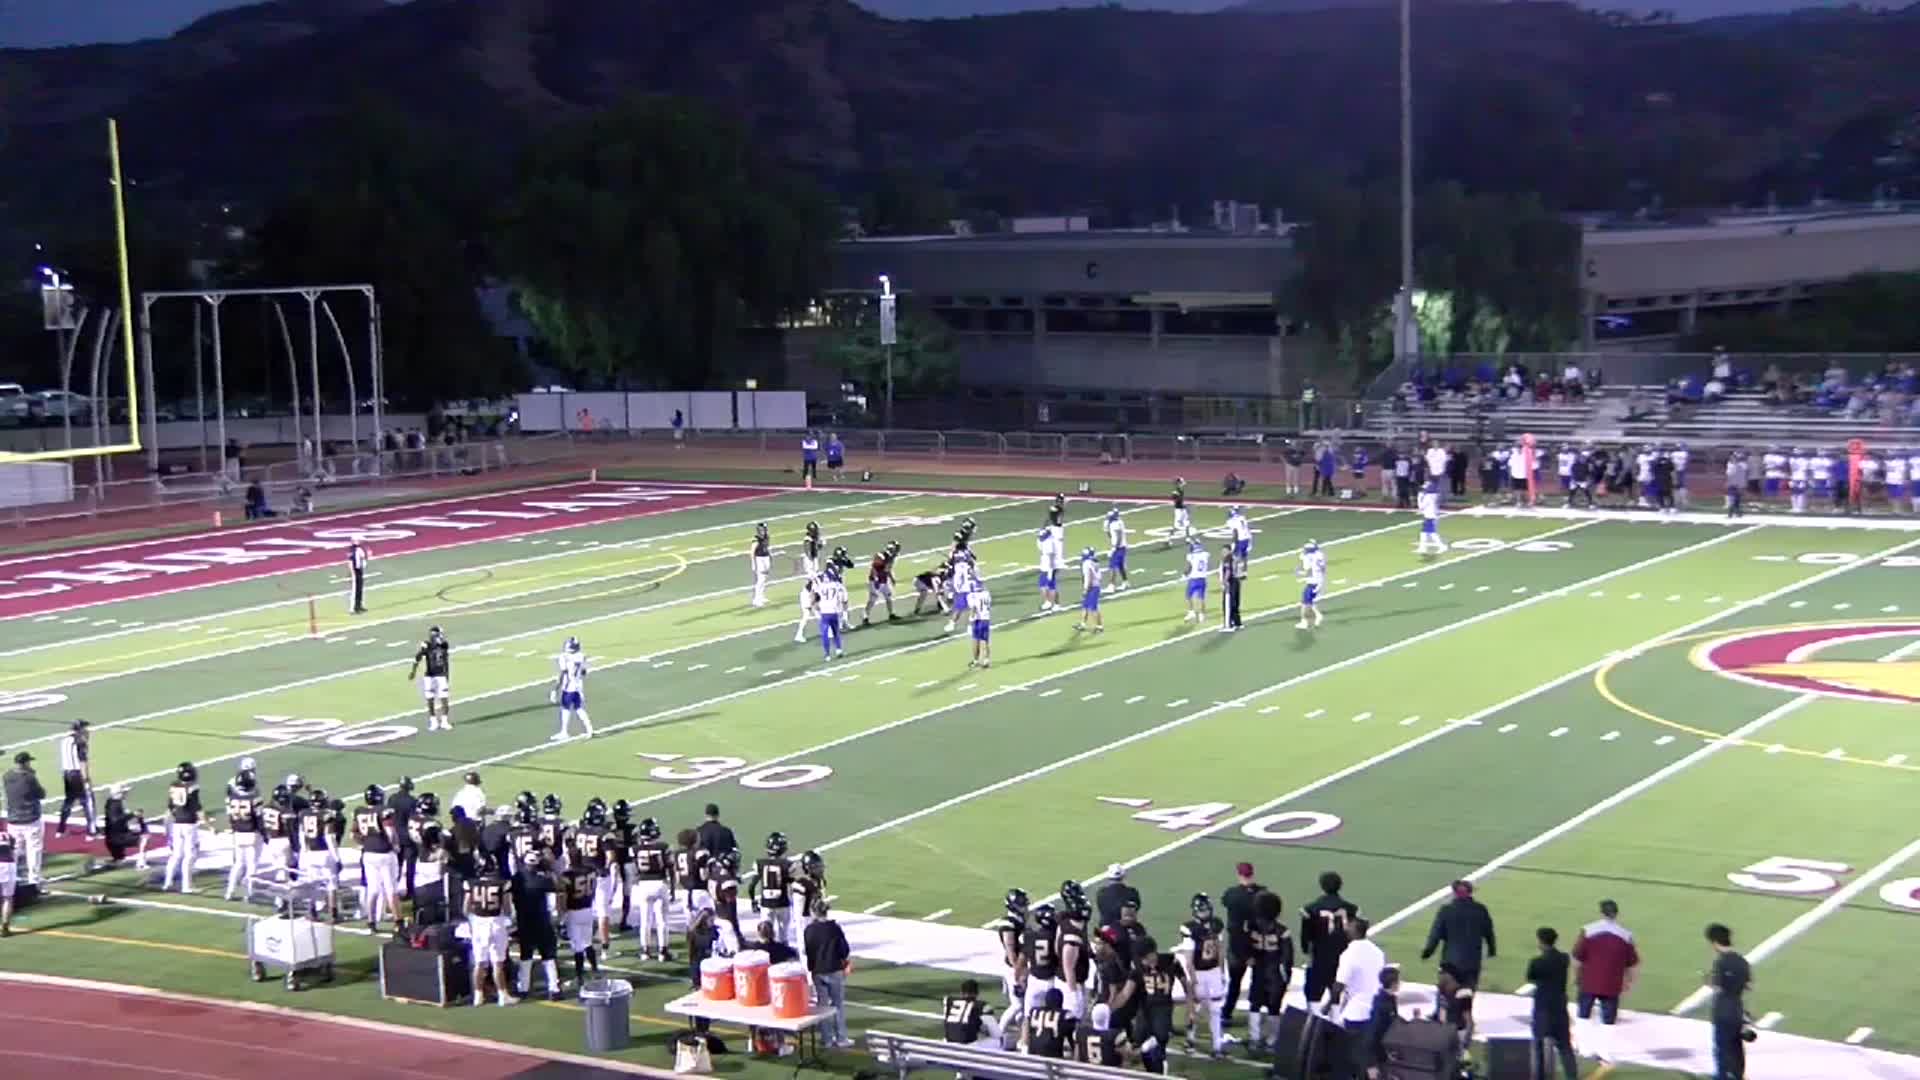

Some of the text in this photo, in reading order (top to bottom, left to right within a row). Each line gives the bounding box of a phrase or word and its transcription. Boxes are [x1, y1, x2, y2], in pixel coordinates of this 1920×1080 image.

[650, 756, 833, 788] 30
[1131, 802, 1342, 840] 40
[473, 885, 499, 911] 45
[1035, 939, 1048, 964] 2
[946, 1000, 974, 1023] 31
[1031, 1009, 1059, 1037] 44
